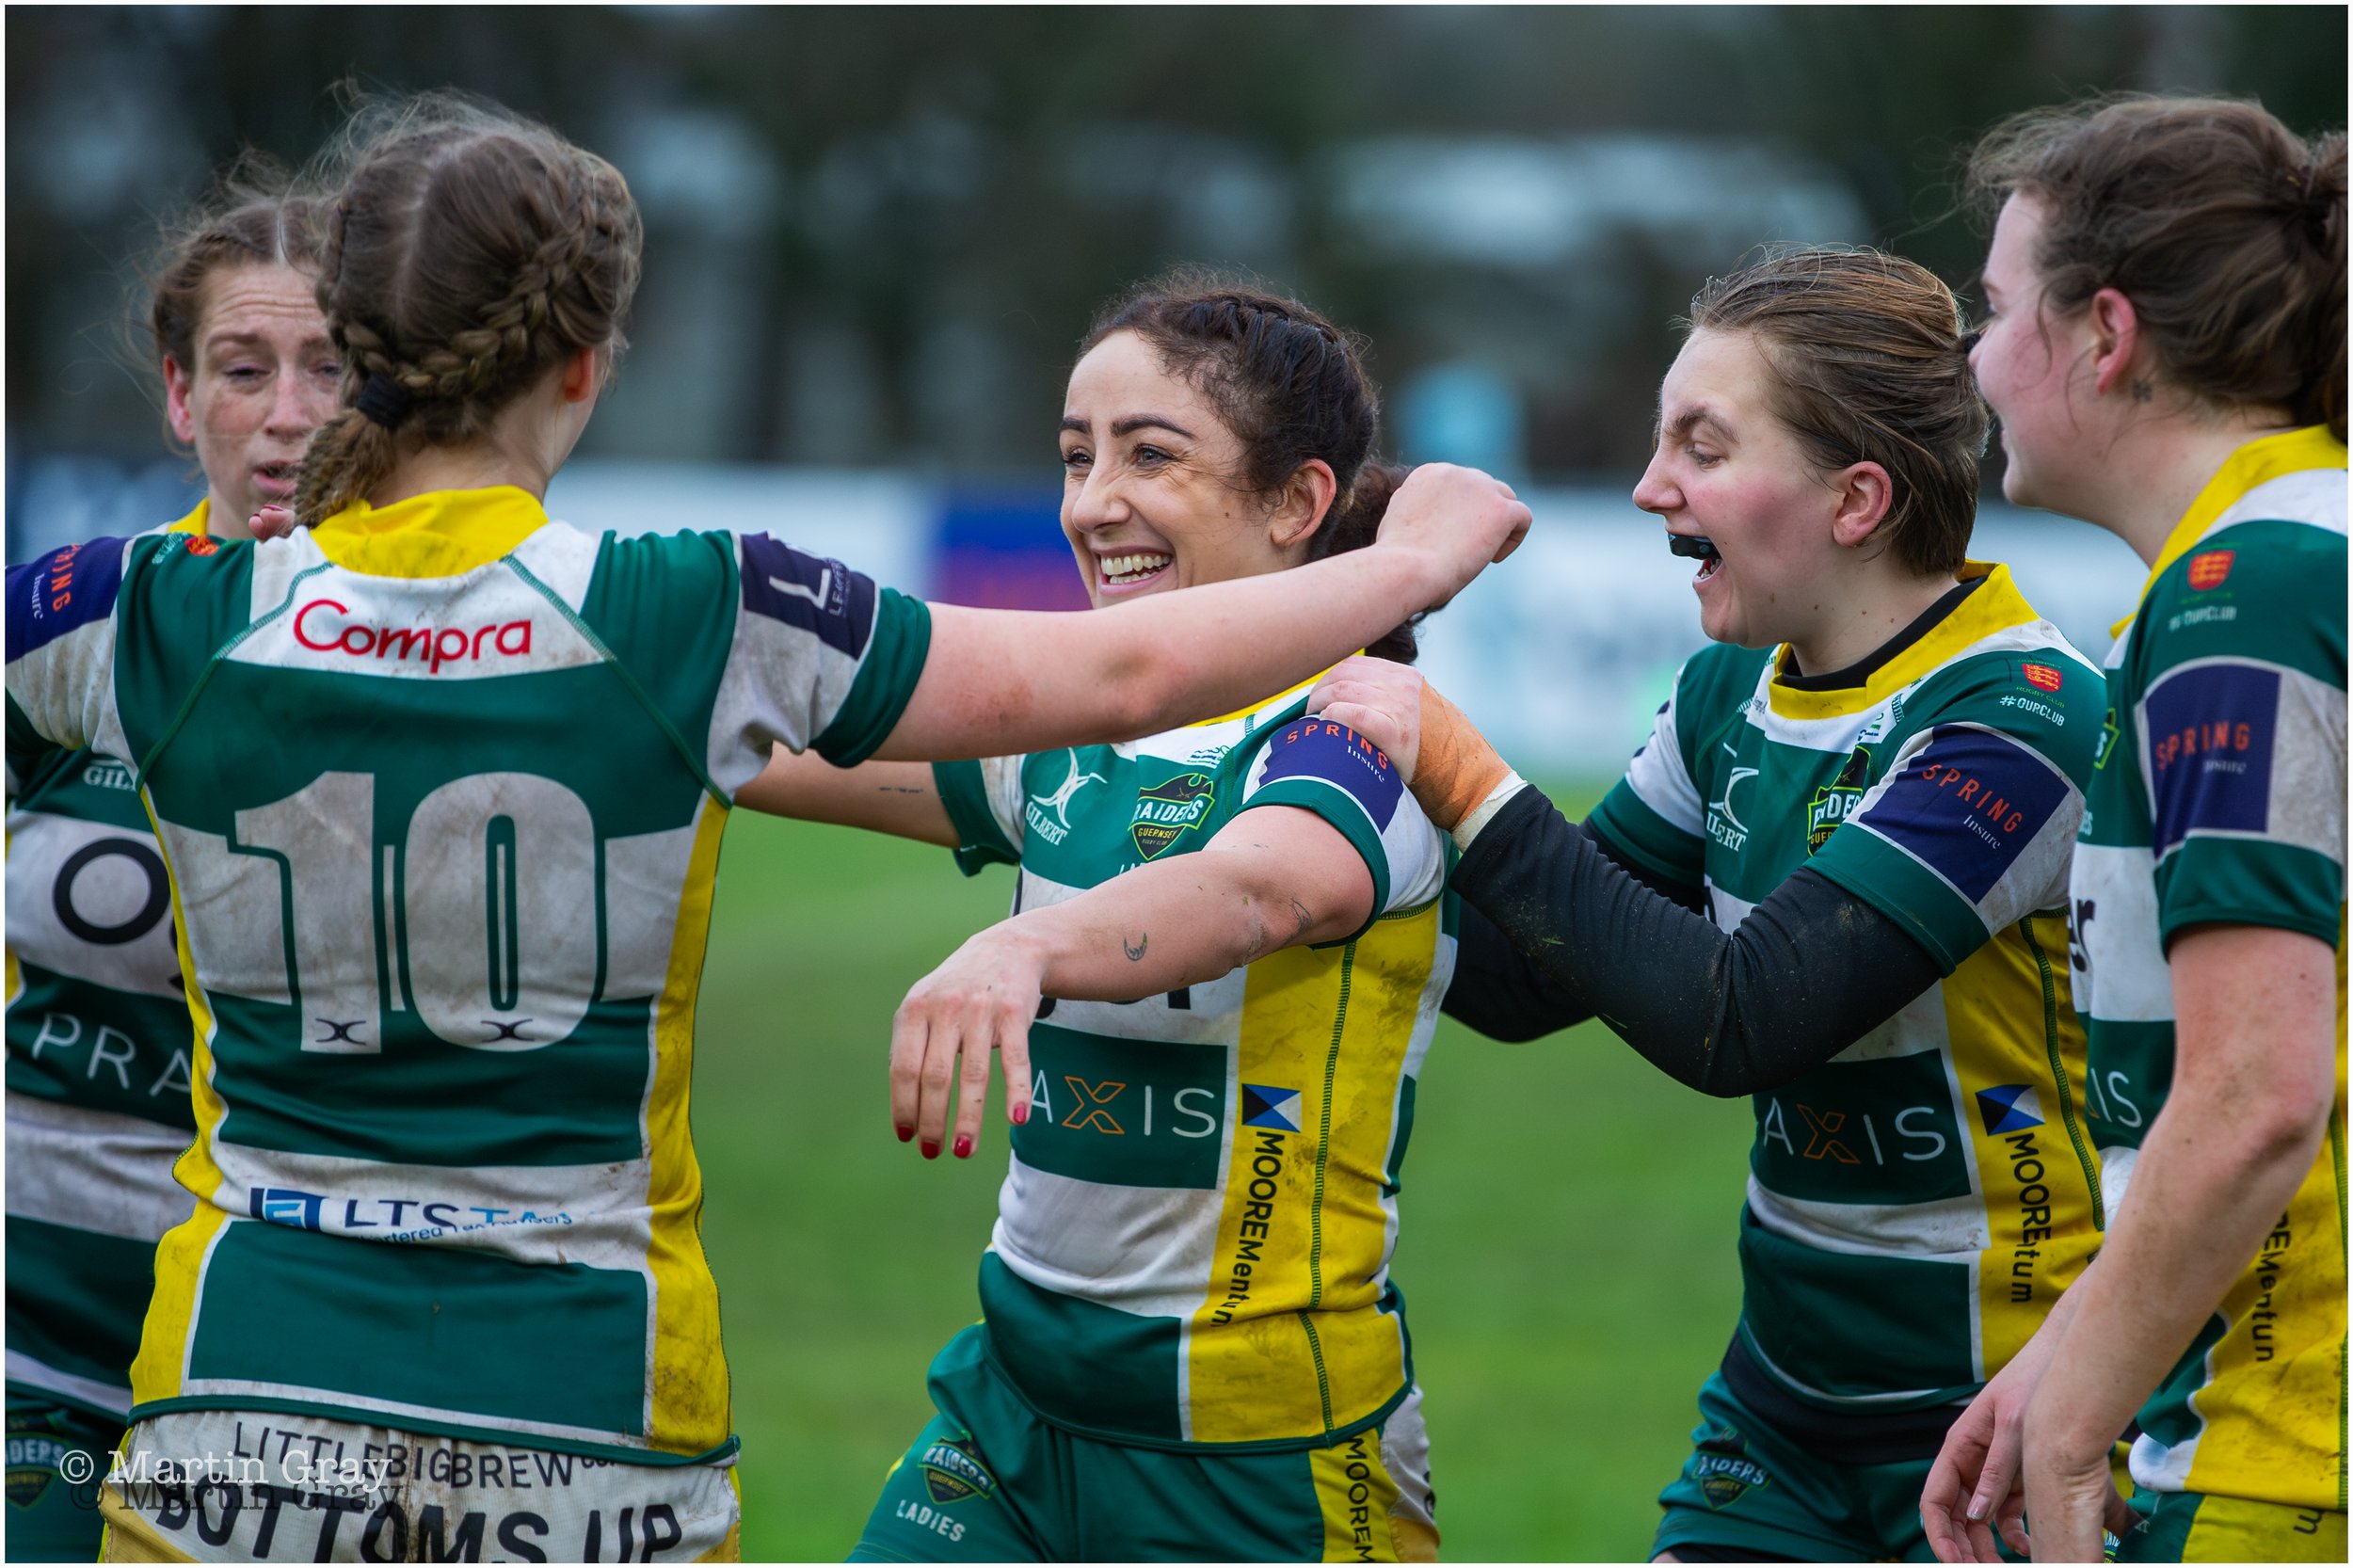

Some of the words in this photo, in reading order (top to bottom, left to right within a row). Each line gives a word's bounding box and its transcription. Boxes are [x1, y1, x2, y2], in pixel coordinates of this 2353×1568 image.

[294, 600, 532, 674] Compra
[1999, 695, 2066, 727] #OURCLUB
[1286, 724, 1388, 770] SPRING
[1347, 744, 1386, 783] Insure
[2156, 720, 2250, 771] SPRING
[1922, 763, 2023, 833] SPRING
[1025, 801, 1068, 846] GILBERT
[1962, 814, 2002, 850] Insure
[235, 772, 596, 1052] 10
[1032, 1067, 1217, 1140] AXIS
[1763, 1096, 1947, 1166] AXIS
[344, 1199, 459, 1227] LTS
[5, 1437, 68, 1469] DERS
[155, 1461, 550, 1563] BOTTOMS
[584, 1503, 682, 1563] UP
[896, 1498, 967, 1542] LADIES
